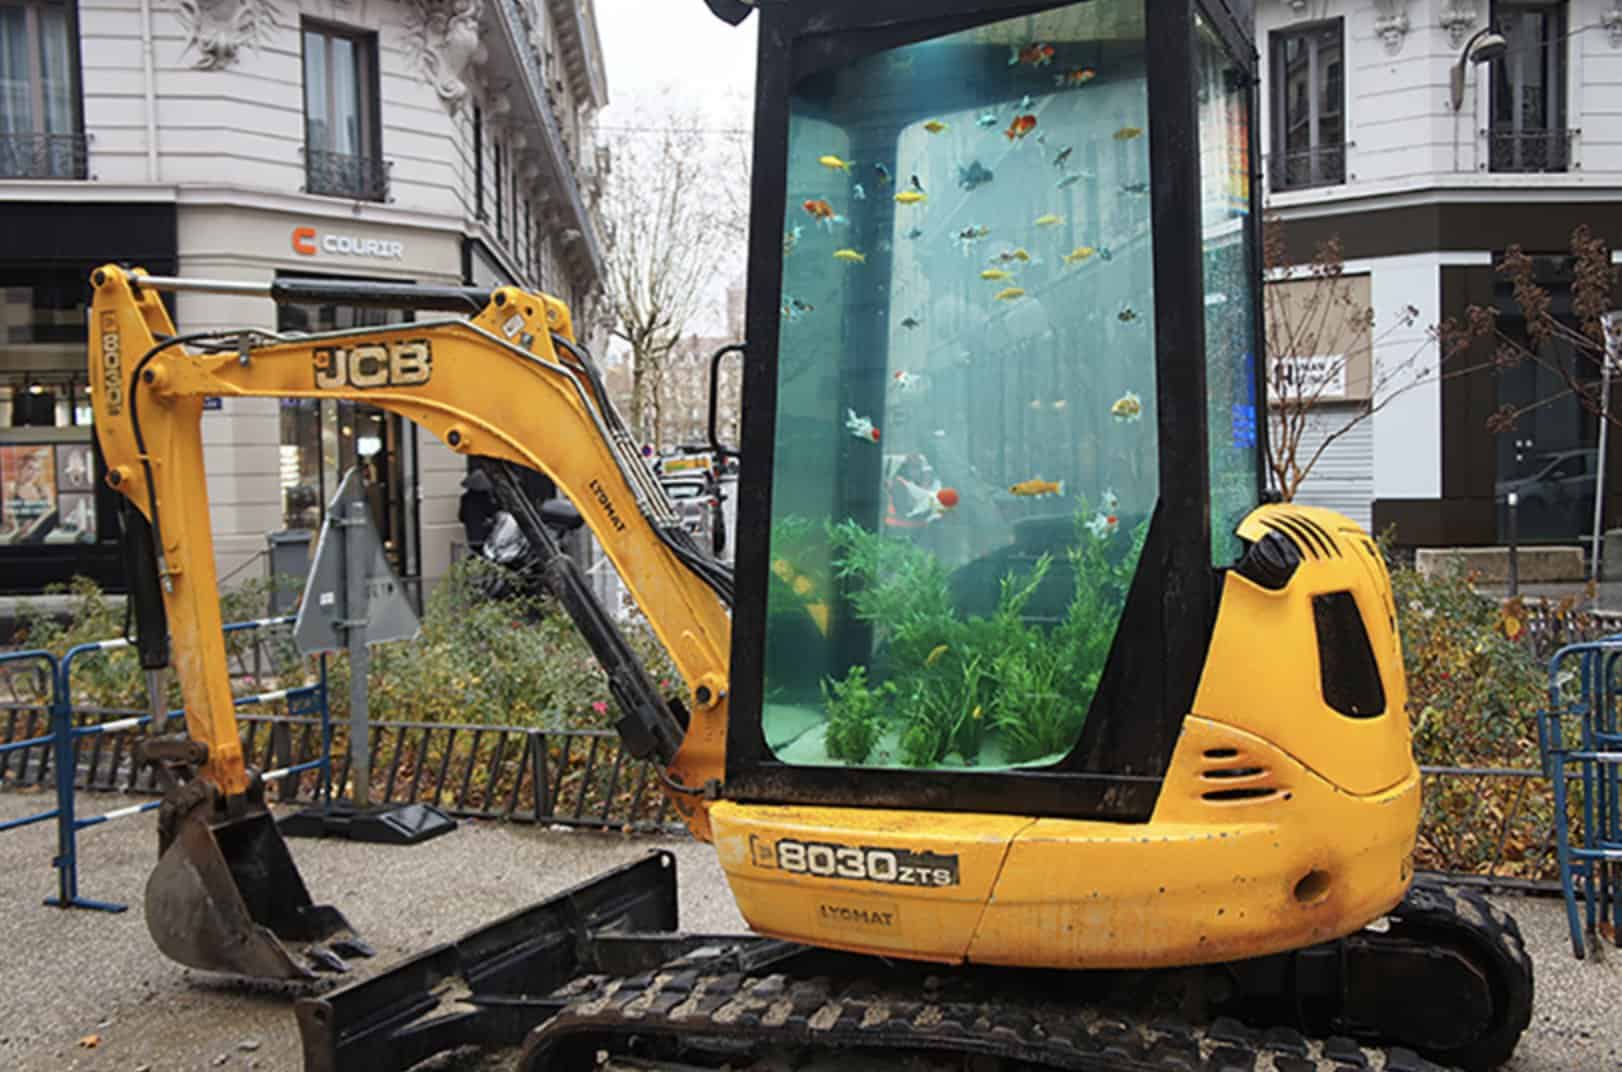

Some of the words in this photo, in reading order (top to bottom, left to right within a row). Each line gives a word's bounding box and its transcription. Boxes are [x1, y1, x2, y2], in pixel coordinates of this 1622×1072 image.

[322, 235, 402, 257] COURIR
[315, 342, 430, 390] JCB
[778, 841, 897, 883] 8030
[899, 866, 951, 886] ZTS
